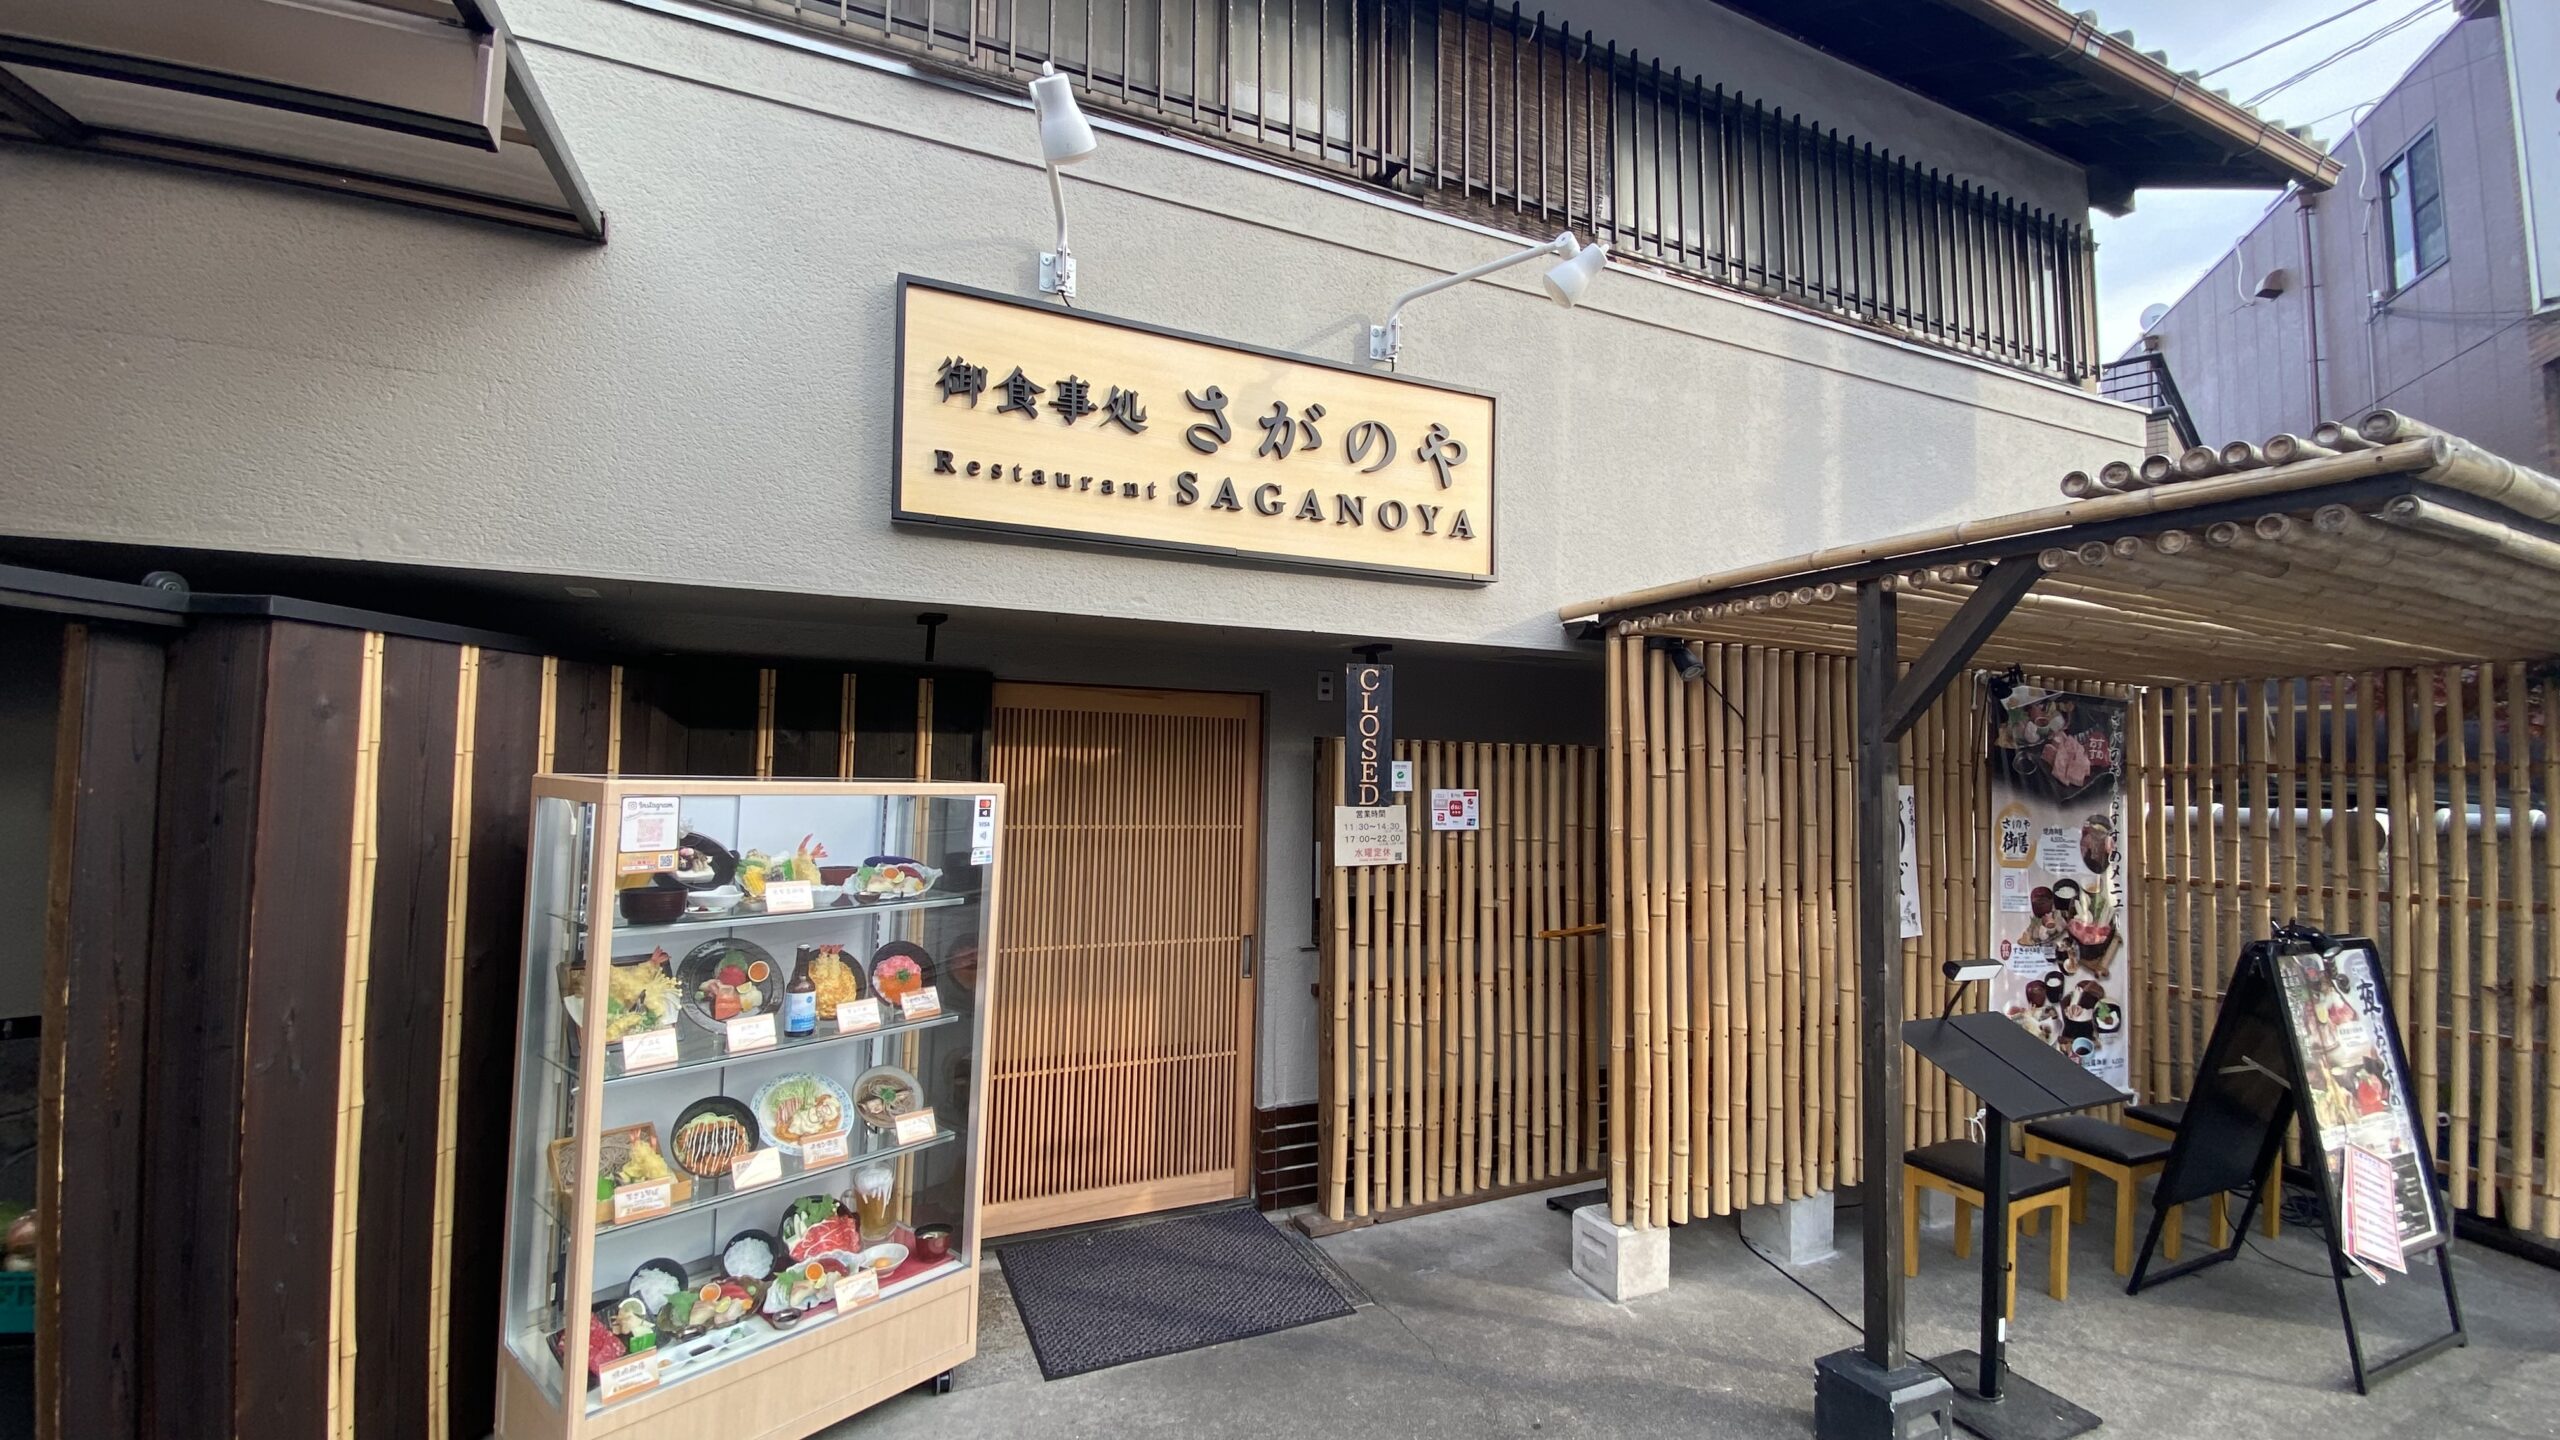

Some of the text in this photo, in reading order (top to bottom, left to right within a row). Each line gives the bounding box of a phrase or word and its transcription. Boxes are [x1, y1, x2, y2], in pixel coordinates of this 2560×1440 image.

[934, 355, 1468, 490] 御食事処 さがのや
[933, 449, 1477, 541] Restaurant SAGANOYA
[1358, 668, 1380, 806] CLOSED
[638, 801, 673, 811] Instagram
[1356, 810, 1386, 818] 営業時間
